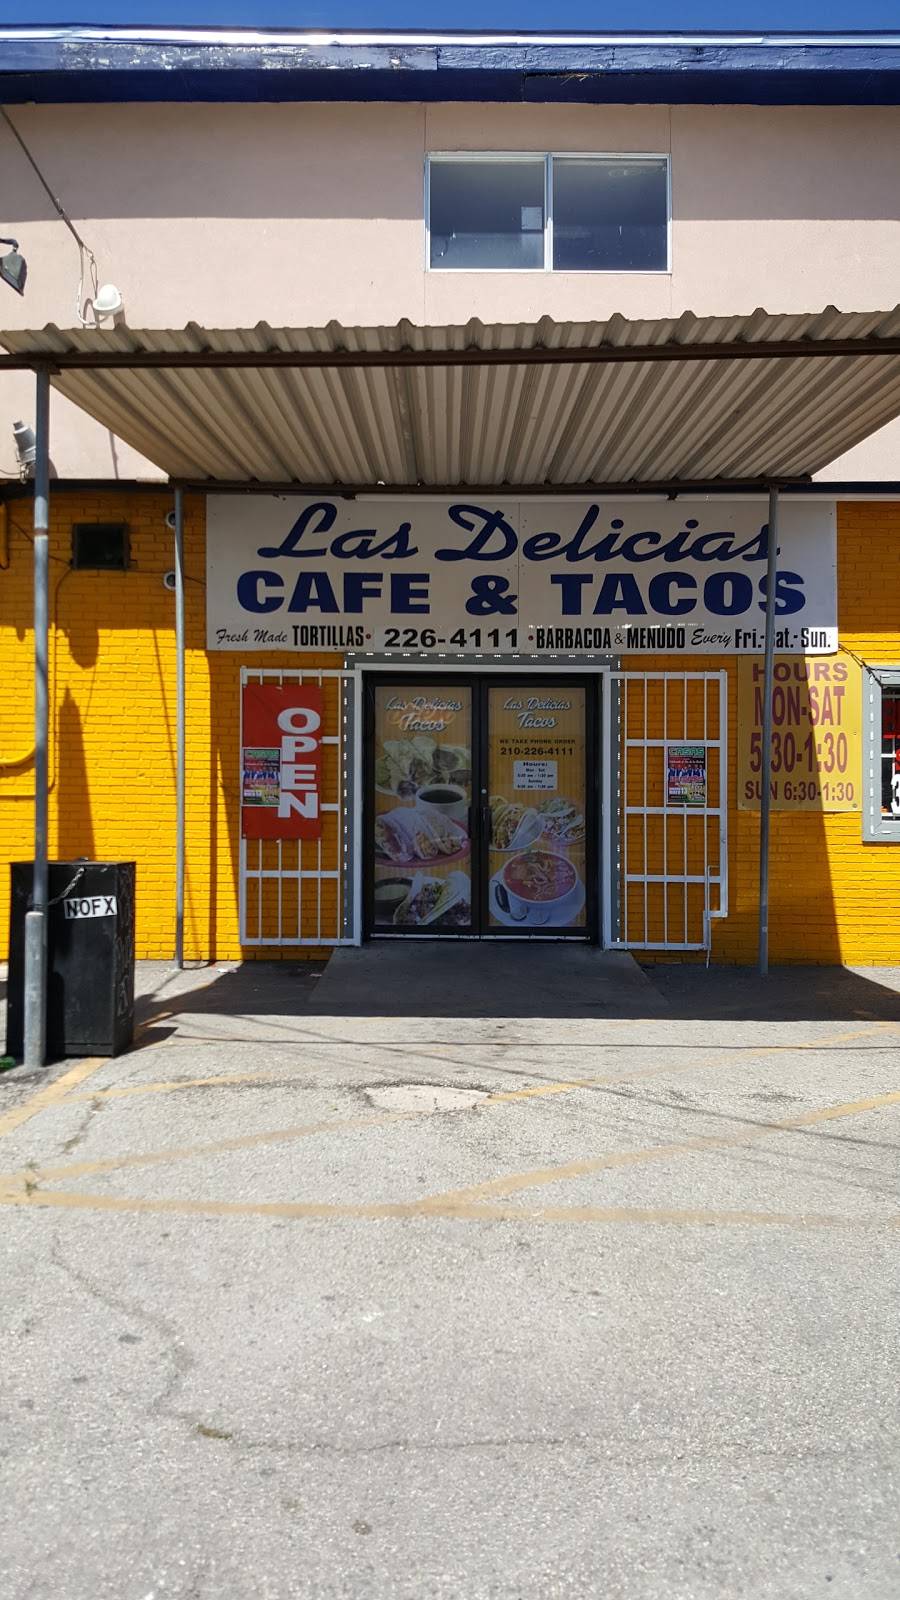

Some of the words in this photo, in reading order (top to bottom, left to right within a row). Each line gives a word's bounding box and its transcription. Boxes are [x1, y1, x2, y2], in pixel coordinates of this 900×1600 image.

[257, 502, 419, 560] Las
[434, 503, 781, 563] Delicias
[236, 570, 431, 614] CAFE
[465, 574, 518, 616] &
[550, 571, 806, 616] TACOS
[215, 628, 249, 645] Fresh
[252, 629, 288, 644] Made
[292, 625, 364, 647] TORTILLAS
[384, 628, 518, 648] 226-4111
[536, 627, 612, 649] BARBACOA
[614, 632, 624, 645] &
[627, 627, 686, 649] MENUDO
[691, 627, 732, 646] Every
[504, 698, 522, 711] Las
[527, 697, 571, 711] Delicias
[400, 712, 447, 732] Tacos
[518, 711, 558, 729] Tacos
[501, 747, 573, 755] 210-226-4111
[750, 732, 848, 773] 530-1:30
[277, 707, 320, 819] OPEN
[784, 782, 854, 802] 6:30-1:30
[66, 897, 115, 918] NOFX
